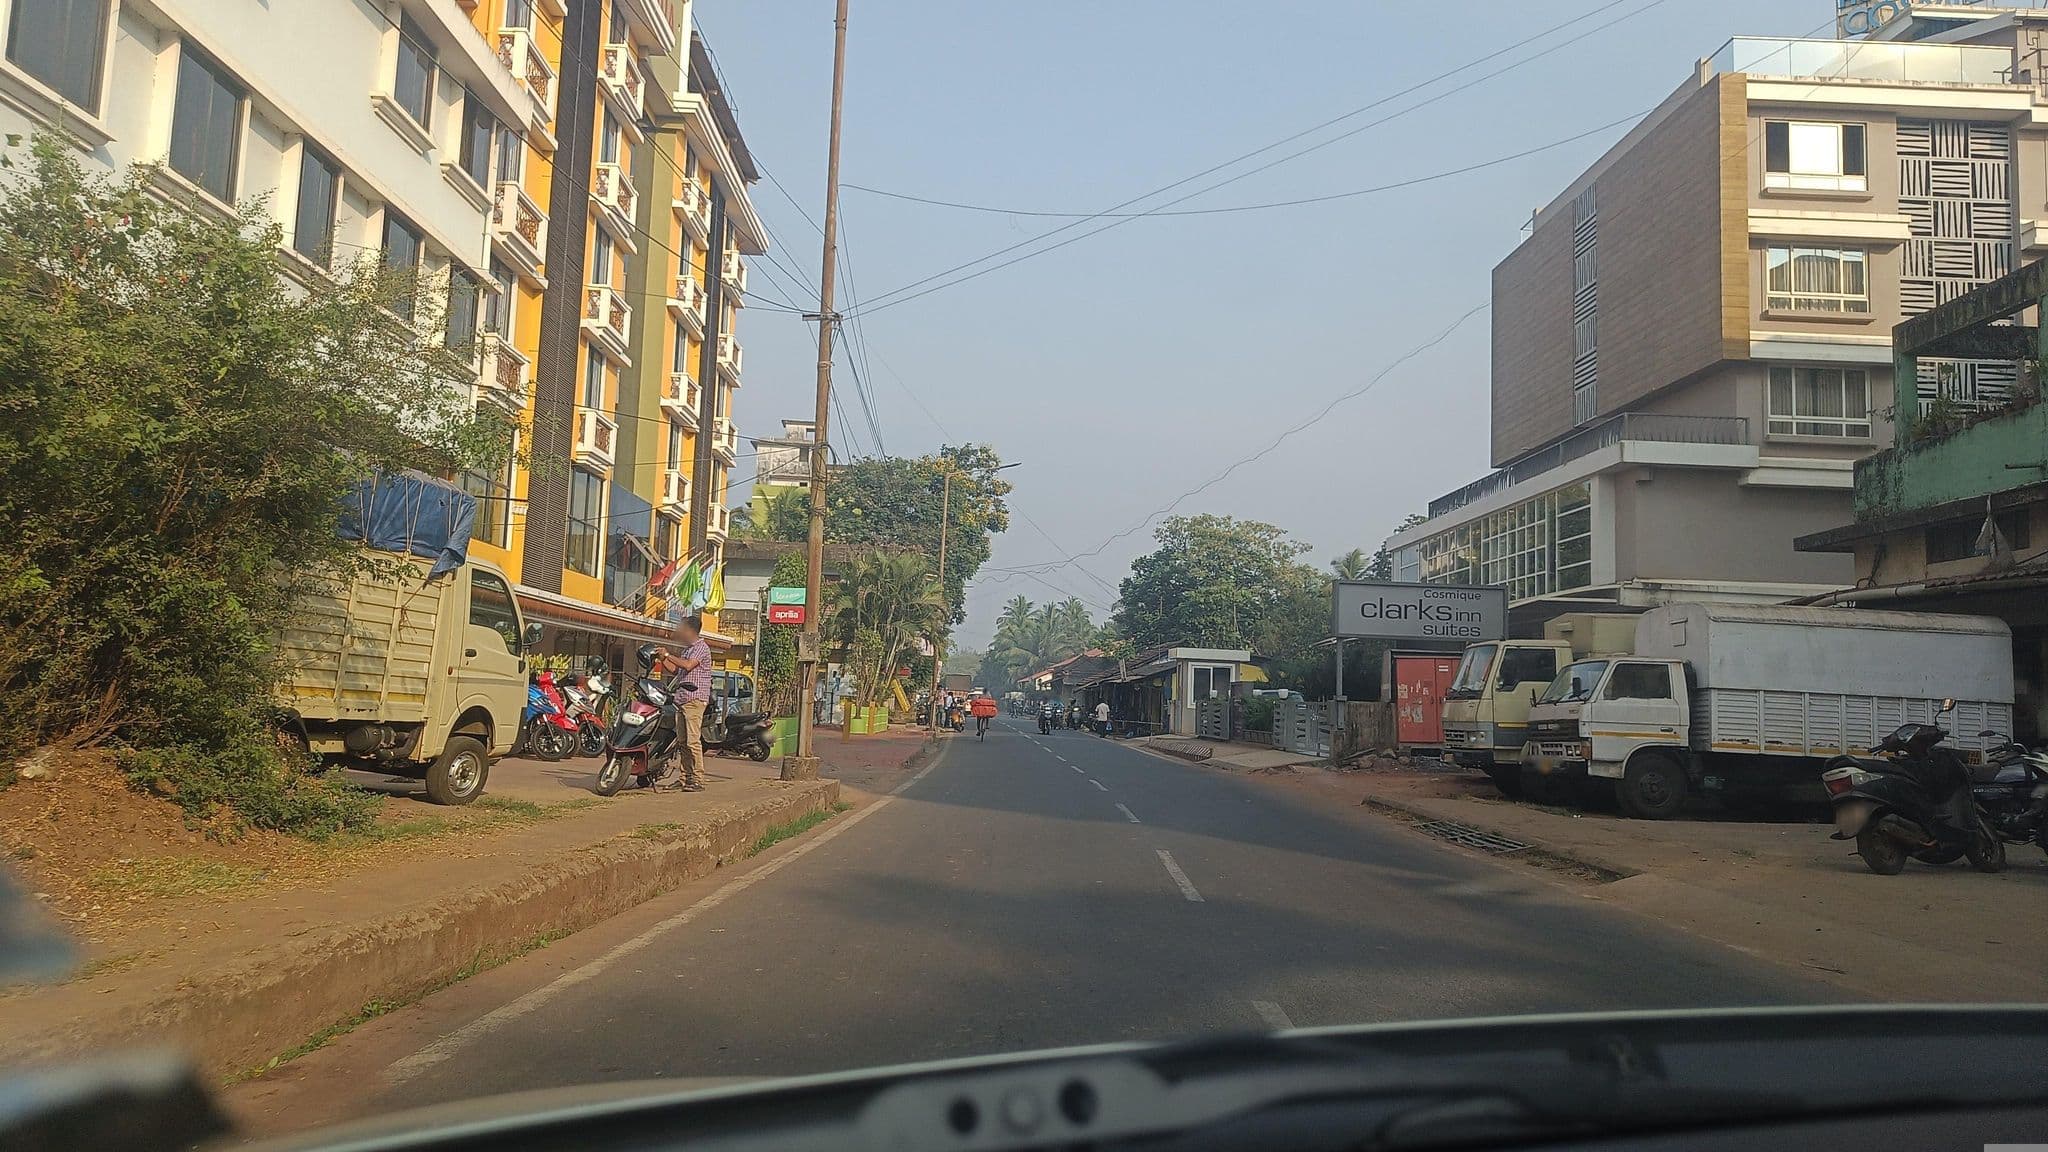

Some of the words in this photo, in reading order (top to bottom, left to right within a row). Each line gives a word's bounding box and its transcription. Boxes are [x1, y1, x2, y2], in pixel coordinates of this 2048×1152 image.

[1423, 588, 1482, 602] Cosmique
[1360, 597, 1452, 621] clarks
[1455, 607, 1482, 622] inn
[1422, 622, 1481, 637] suites
